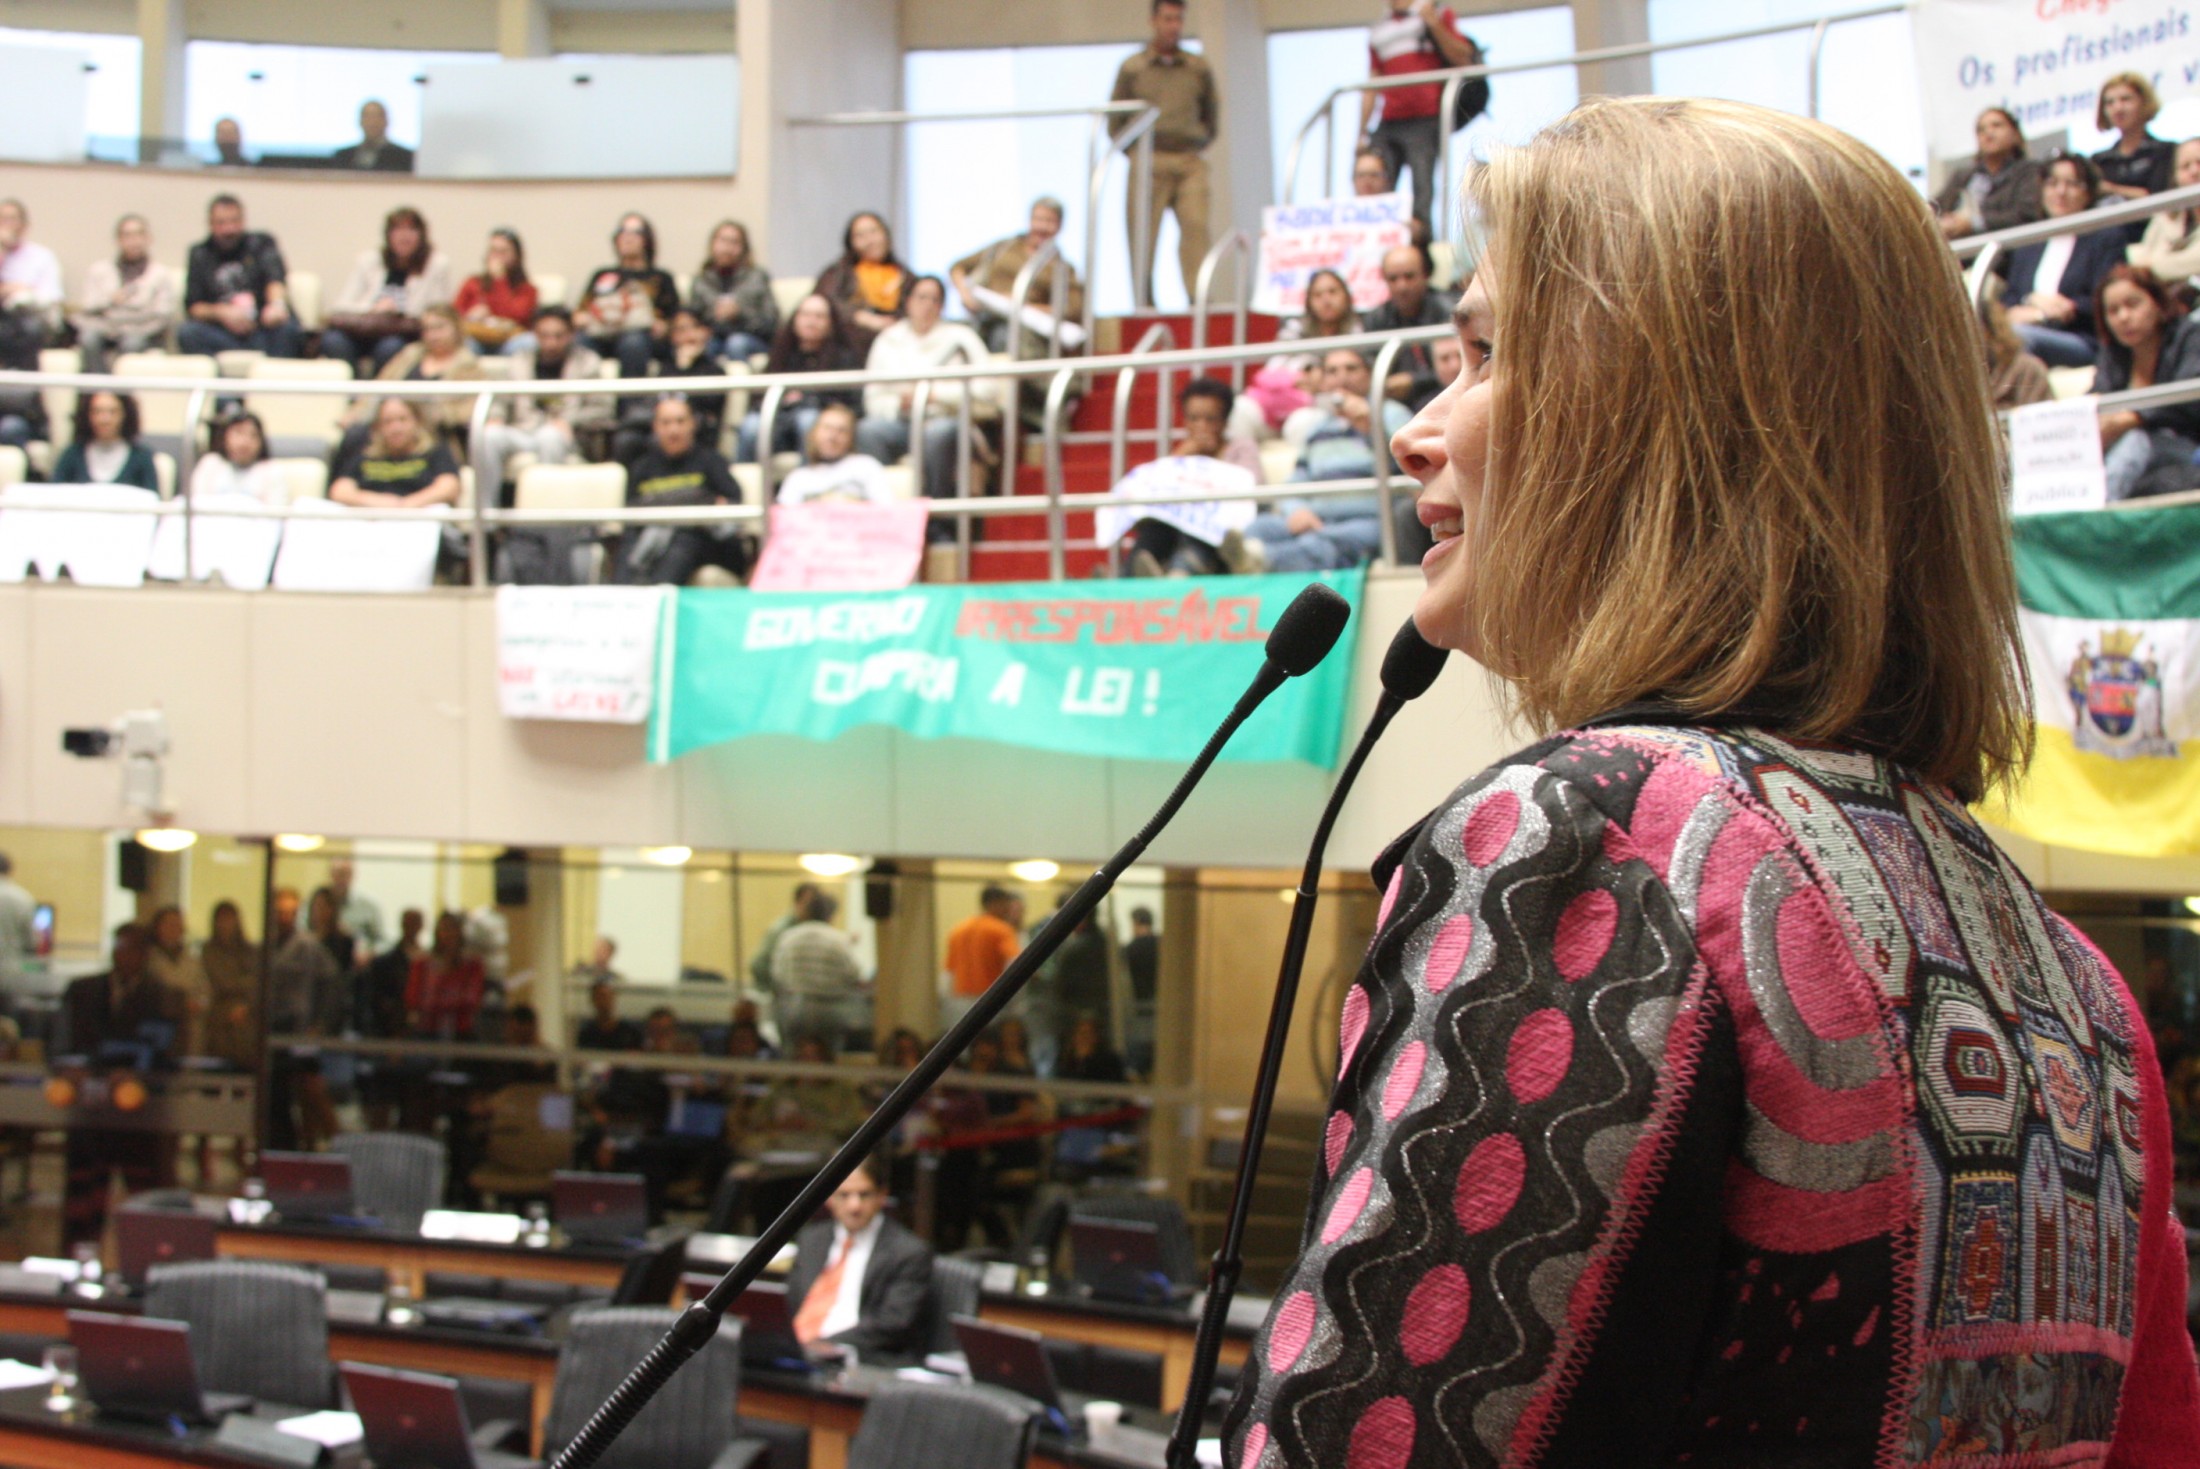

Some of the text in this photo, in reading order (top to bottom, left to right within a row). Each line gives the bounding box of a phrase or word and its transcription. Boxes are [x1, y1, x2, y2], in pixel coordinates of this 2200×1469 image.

[1959, 8, 2190, 88] Os profissionais
[746, 588, 1269, 649] GOVERNO IRRESPONSÁVEL
[992, 663, 1026, 705] A
